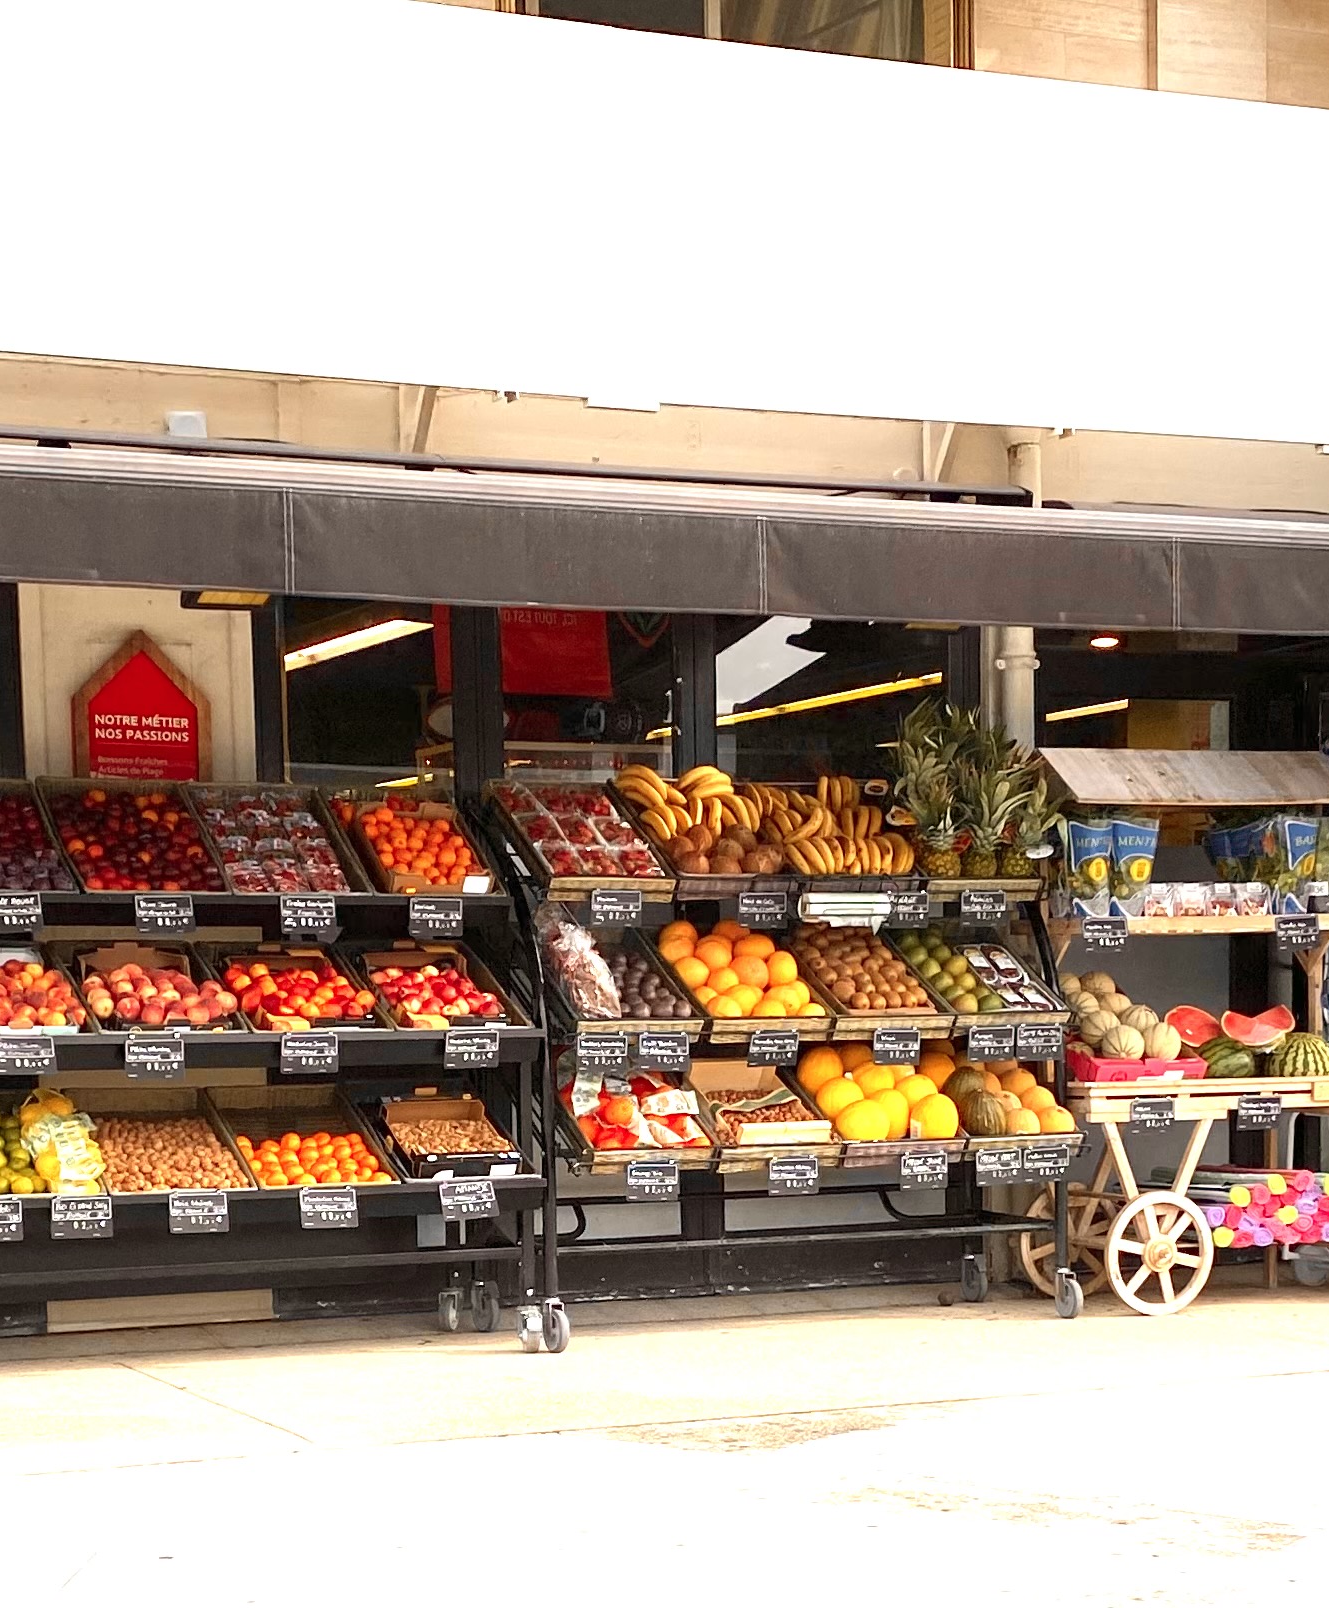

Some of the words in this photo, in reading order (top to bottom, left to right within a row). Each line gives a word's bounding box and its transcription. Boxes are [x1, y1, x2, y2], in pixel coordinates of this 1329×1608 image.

[94, 714, 138, 726] NOTRE
[141, 713, 189, 728] MÉTIER
[95, 728, 122, 739] NOS
[125, 729, 189, 742] PASSIONS
